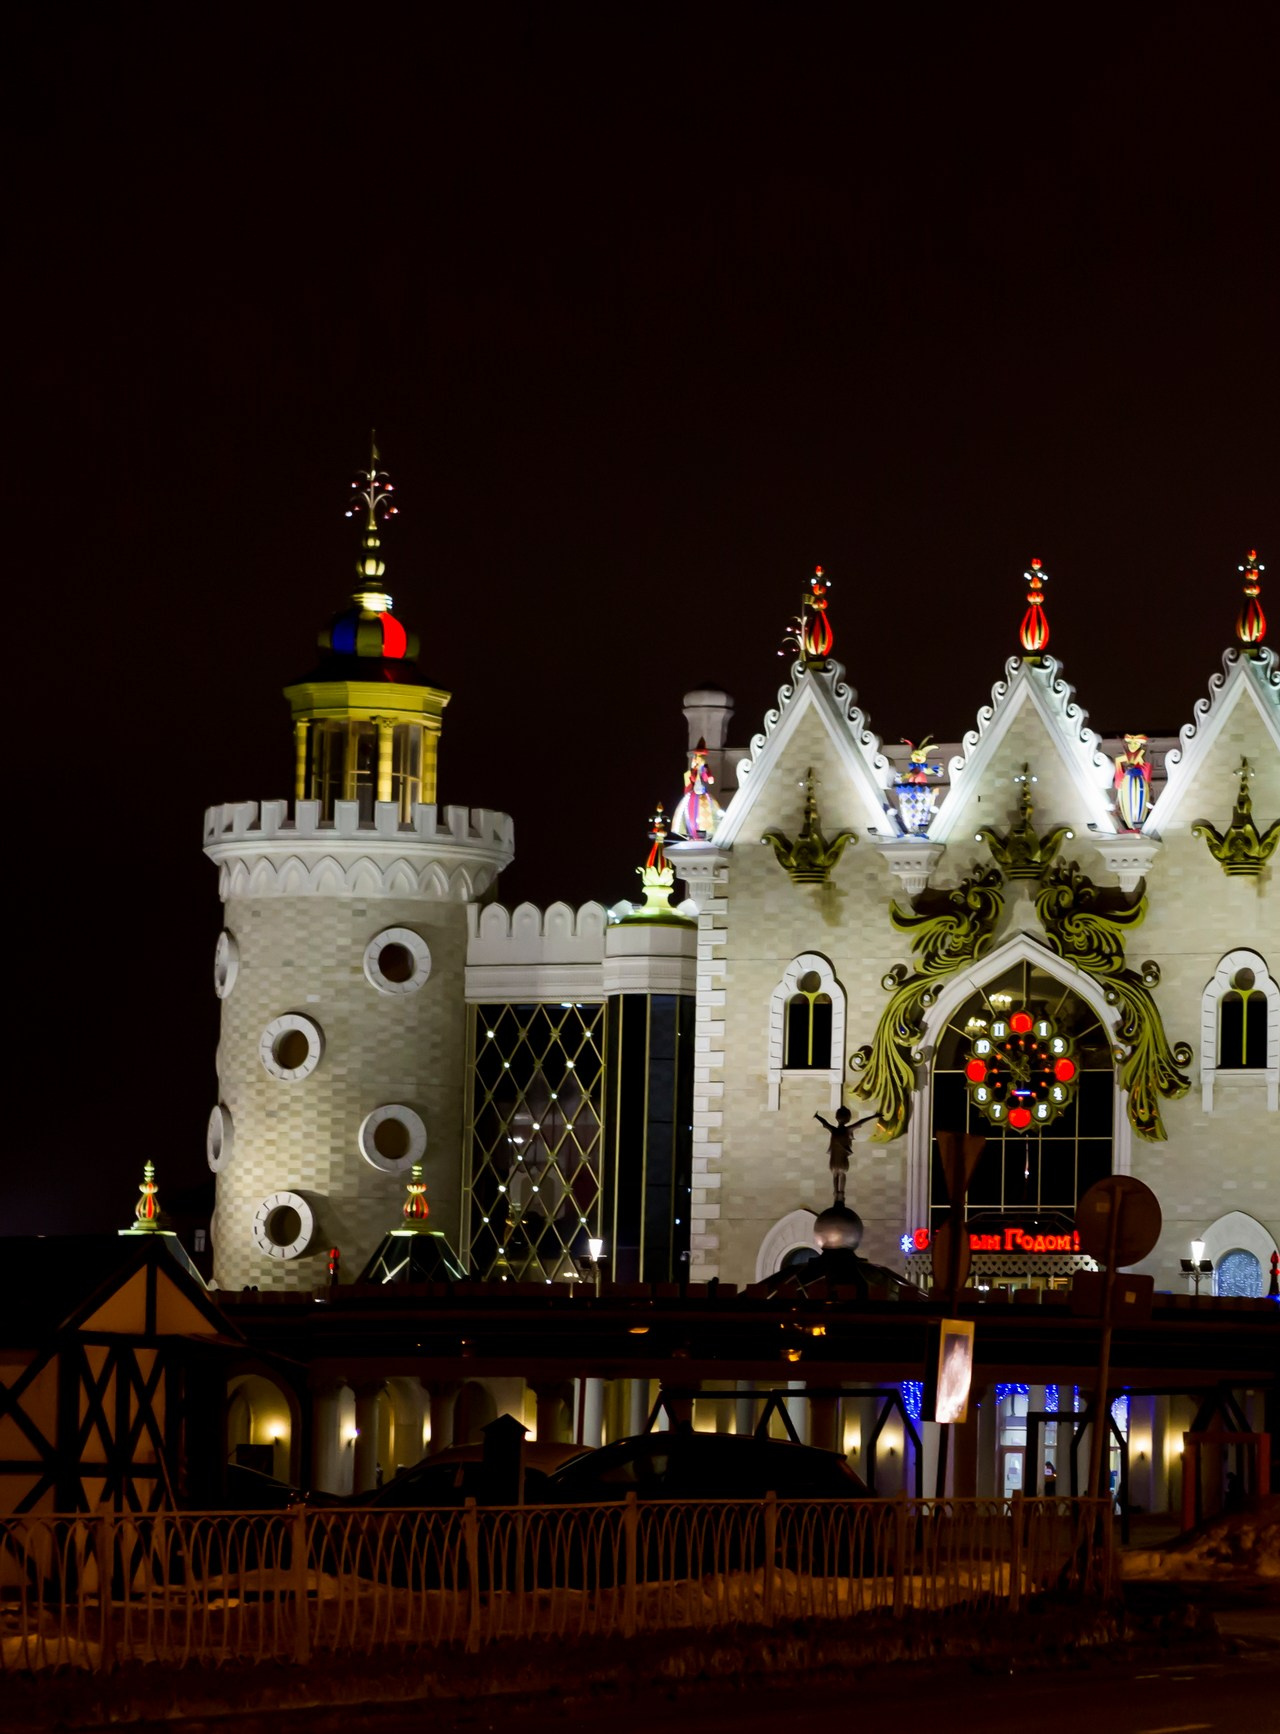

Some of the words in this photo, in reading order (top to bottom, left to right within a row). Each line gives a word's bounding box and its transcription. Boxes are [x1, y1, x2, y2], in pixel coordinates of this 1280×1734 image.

[992, 1022, 1005, 1037] 11
[1039, 1022, 1048, 1037] 1
[976, 1039, 991, 1054] 10
[1053, 1038, 1064, 1053] 2
[977, 1087, 987, 1101] 8
[1053, 1087, 1063, 1101] 4
[992, 1104, 1002, 1118] 7
[1037, 1104, 1048, 1118] 5
